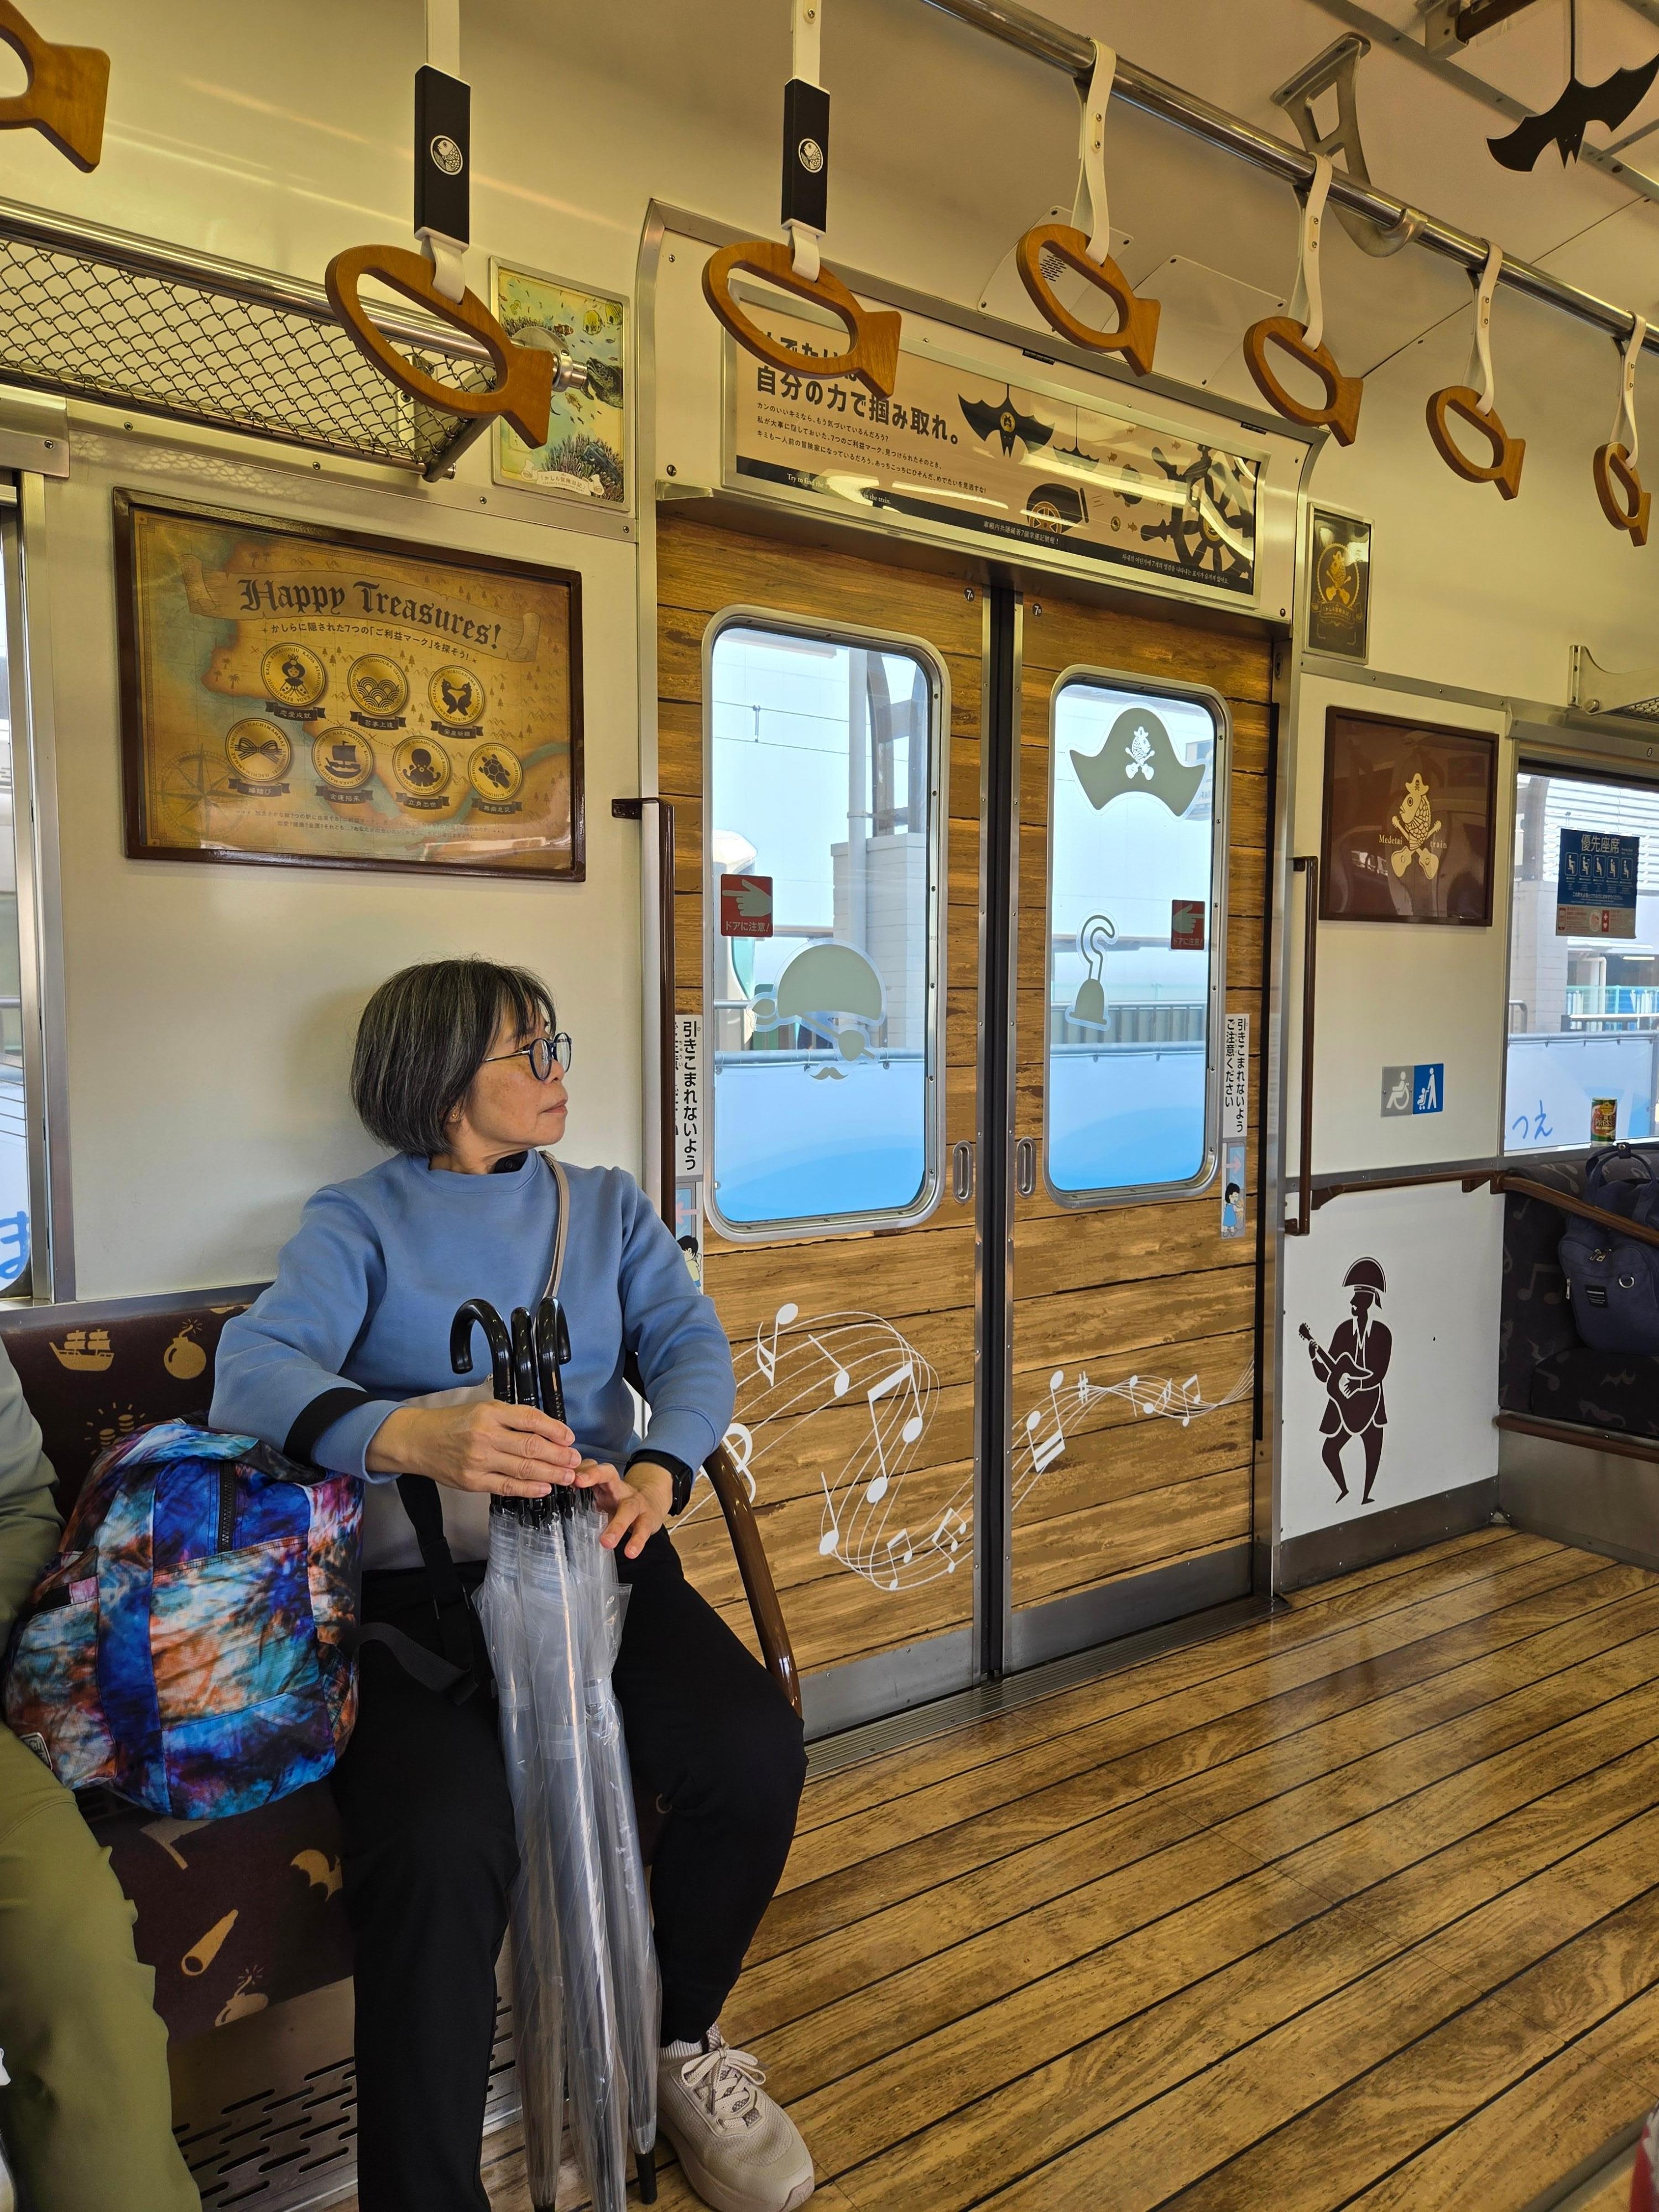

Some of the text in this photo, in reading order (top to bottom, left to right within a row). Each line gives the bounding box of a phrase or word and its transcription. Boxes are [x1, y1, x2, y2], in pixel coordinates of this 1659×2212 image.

[757, 366, 958, 445] 自分の力で掴み取れ。
[787, 473, 796, 484] Try
[804, 477, 815, 486] find
[238, 578, 502, 650] Happy Treasures!
[1379, 834, 1447, 849] Medetai train
[1580, 833, 1620, 854] 優先座席
[726, 921, 770, 932] ドアに注意!
[684, 1020, 698, 1170] 引きこまれないよう
[1225, 1019, 1235, 1107] ご注意ください
[1236, 1018, 1246, 1133] 引きこまれないよう
